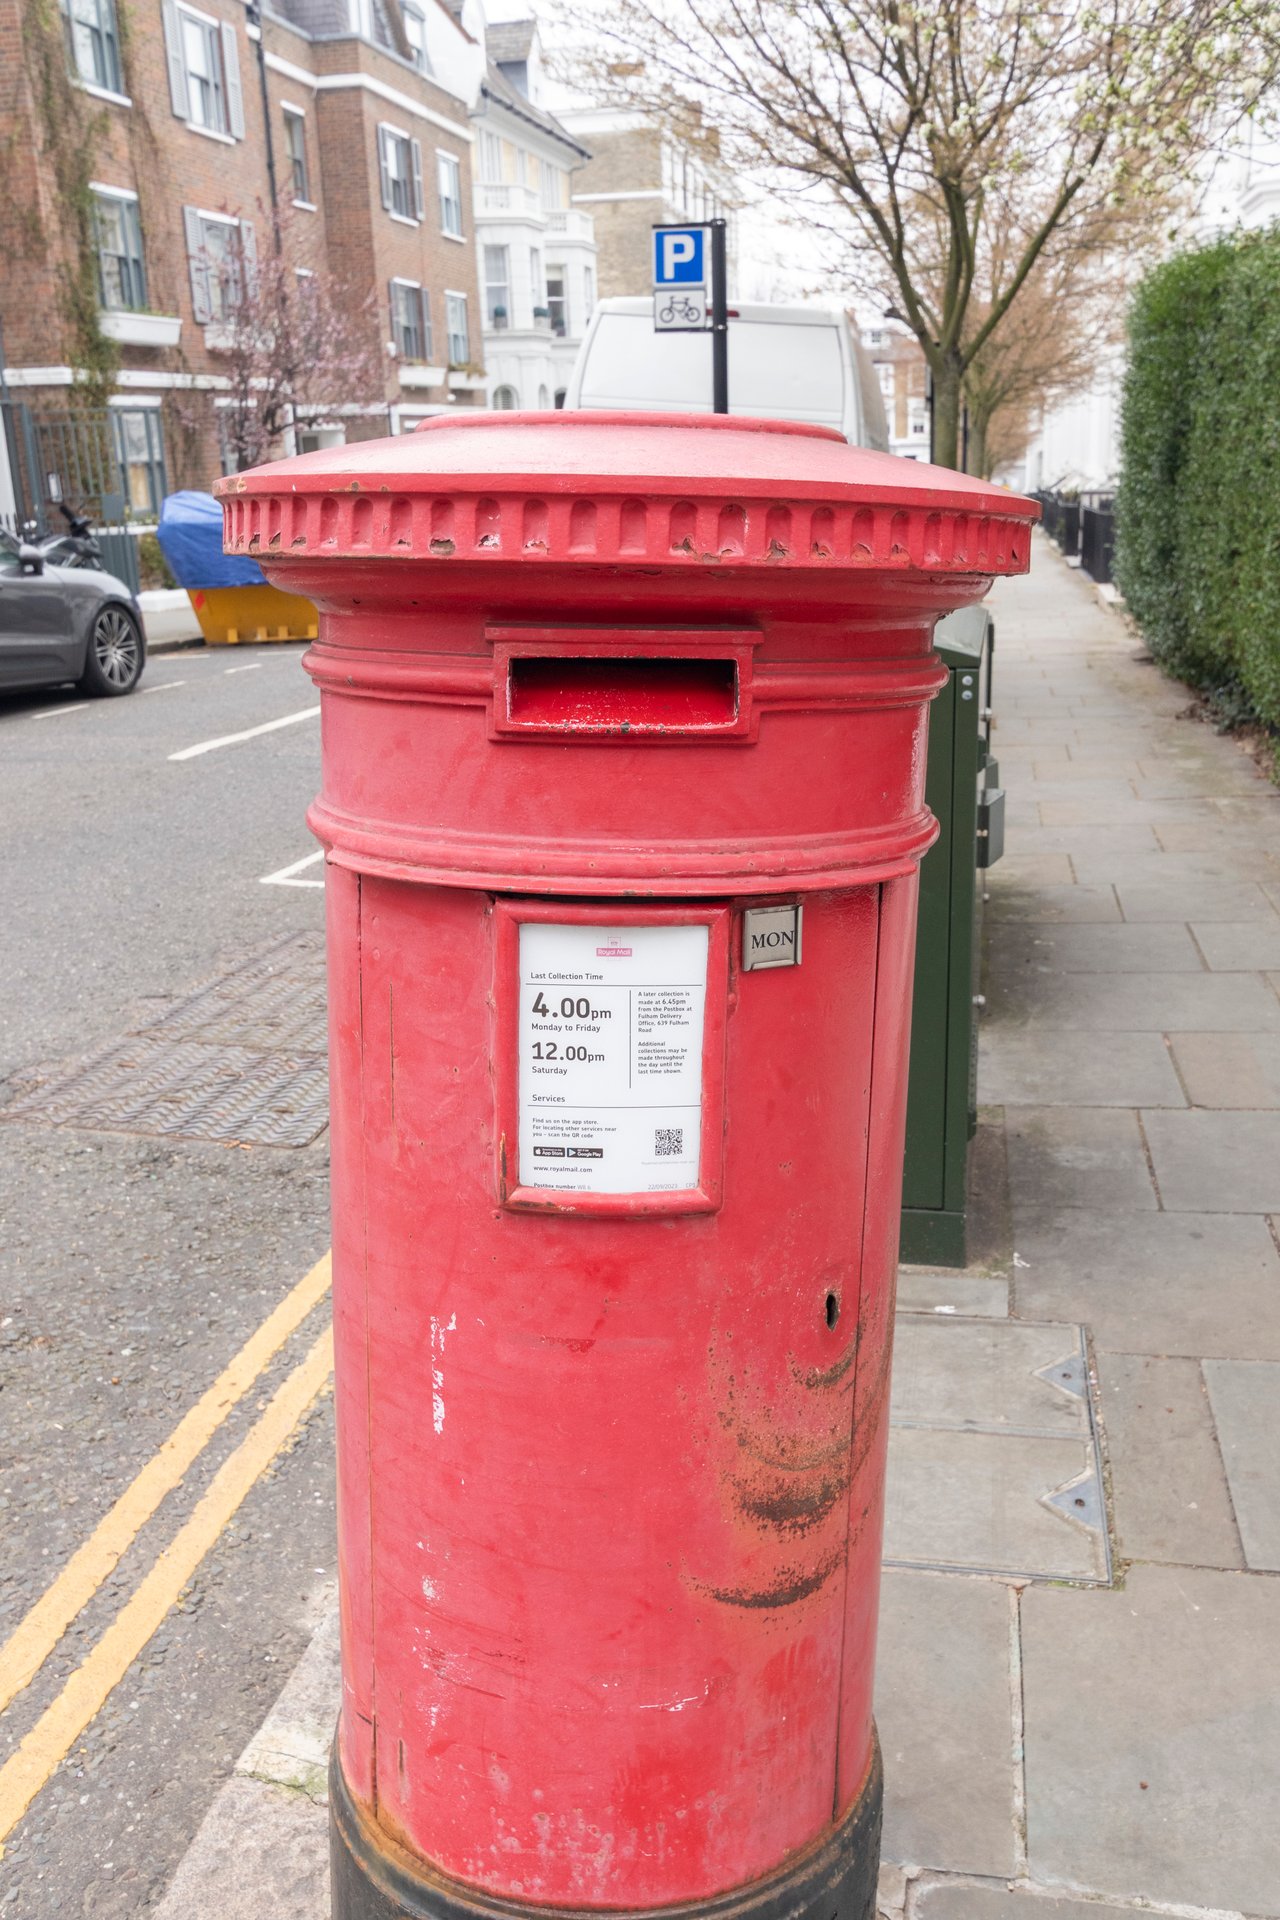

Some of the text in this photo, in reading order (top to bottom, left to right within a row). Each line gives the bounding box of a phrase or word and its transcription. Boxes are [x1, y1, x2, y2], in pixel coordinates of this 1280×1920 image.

[663, 234, 695, 280] P
[752, 930, 794, 949] MON
[532, 992, 612, 1020] 4.00pm
[532, 1023, 562, 1032] Monday
[576, 1024, 600, 1033] Friday
[532, 1042, 605, 1063] 12.00pm
[532, 1065, 568, 1076] Saturday
[532, 1094, 565, 1102] Services
